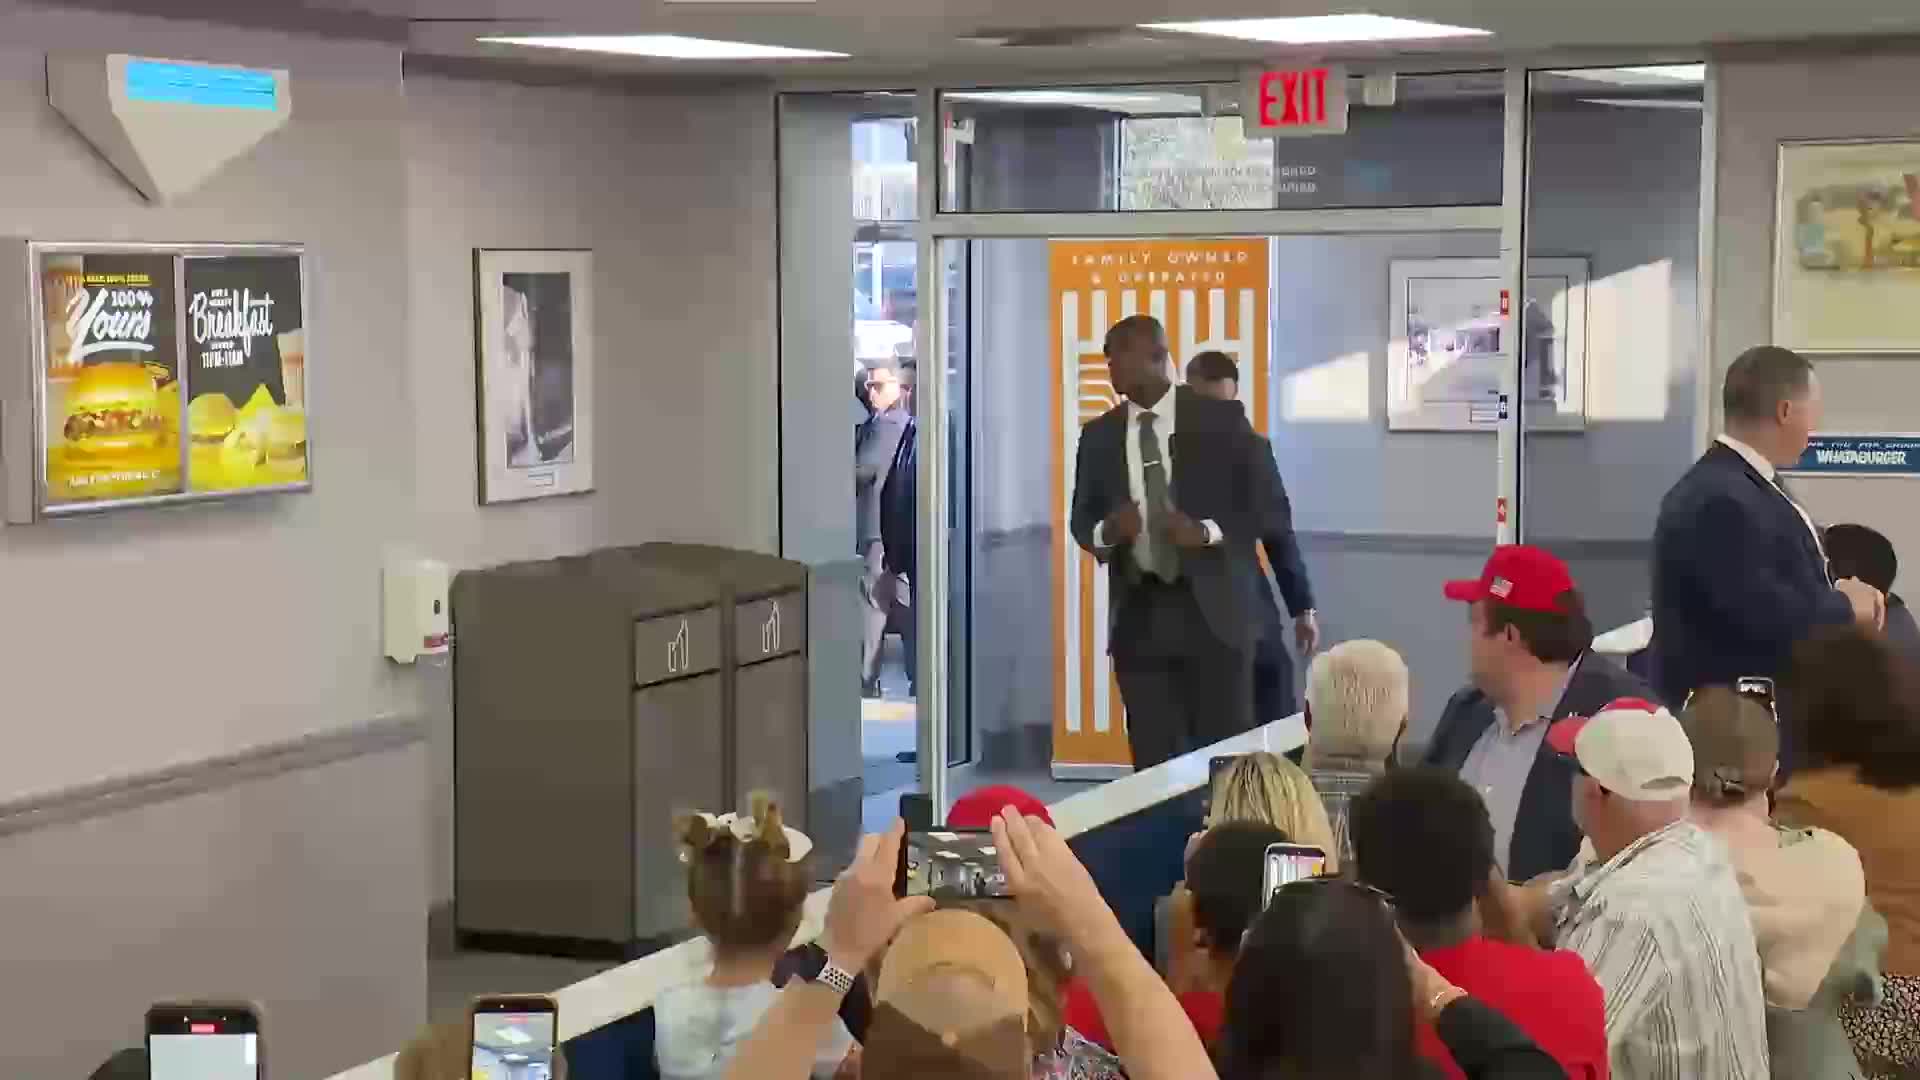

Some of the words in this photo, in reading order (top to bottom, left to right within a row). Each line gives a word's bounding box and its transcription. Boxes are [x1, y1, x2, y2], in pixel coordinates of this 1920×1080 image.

[1260, 68, 1329, 127] EXIT
[1071, 251, 1151, 265] FAMILY
[1167, 251, 1250, 265] OWNED
[111, 288, 154, 307] 100%
[66, 287, 153, 363] Yours
[188, 287, 275, 358] Breakfast
[1815, 448, 1907, 465] WHATABURGER
